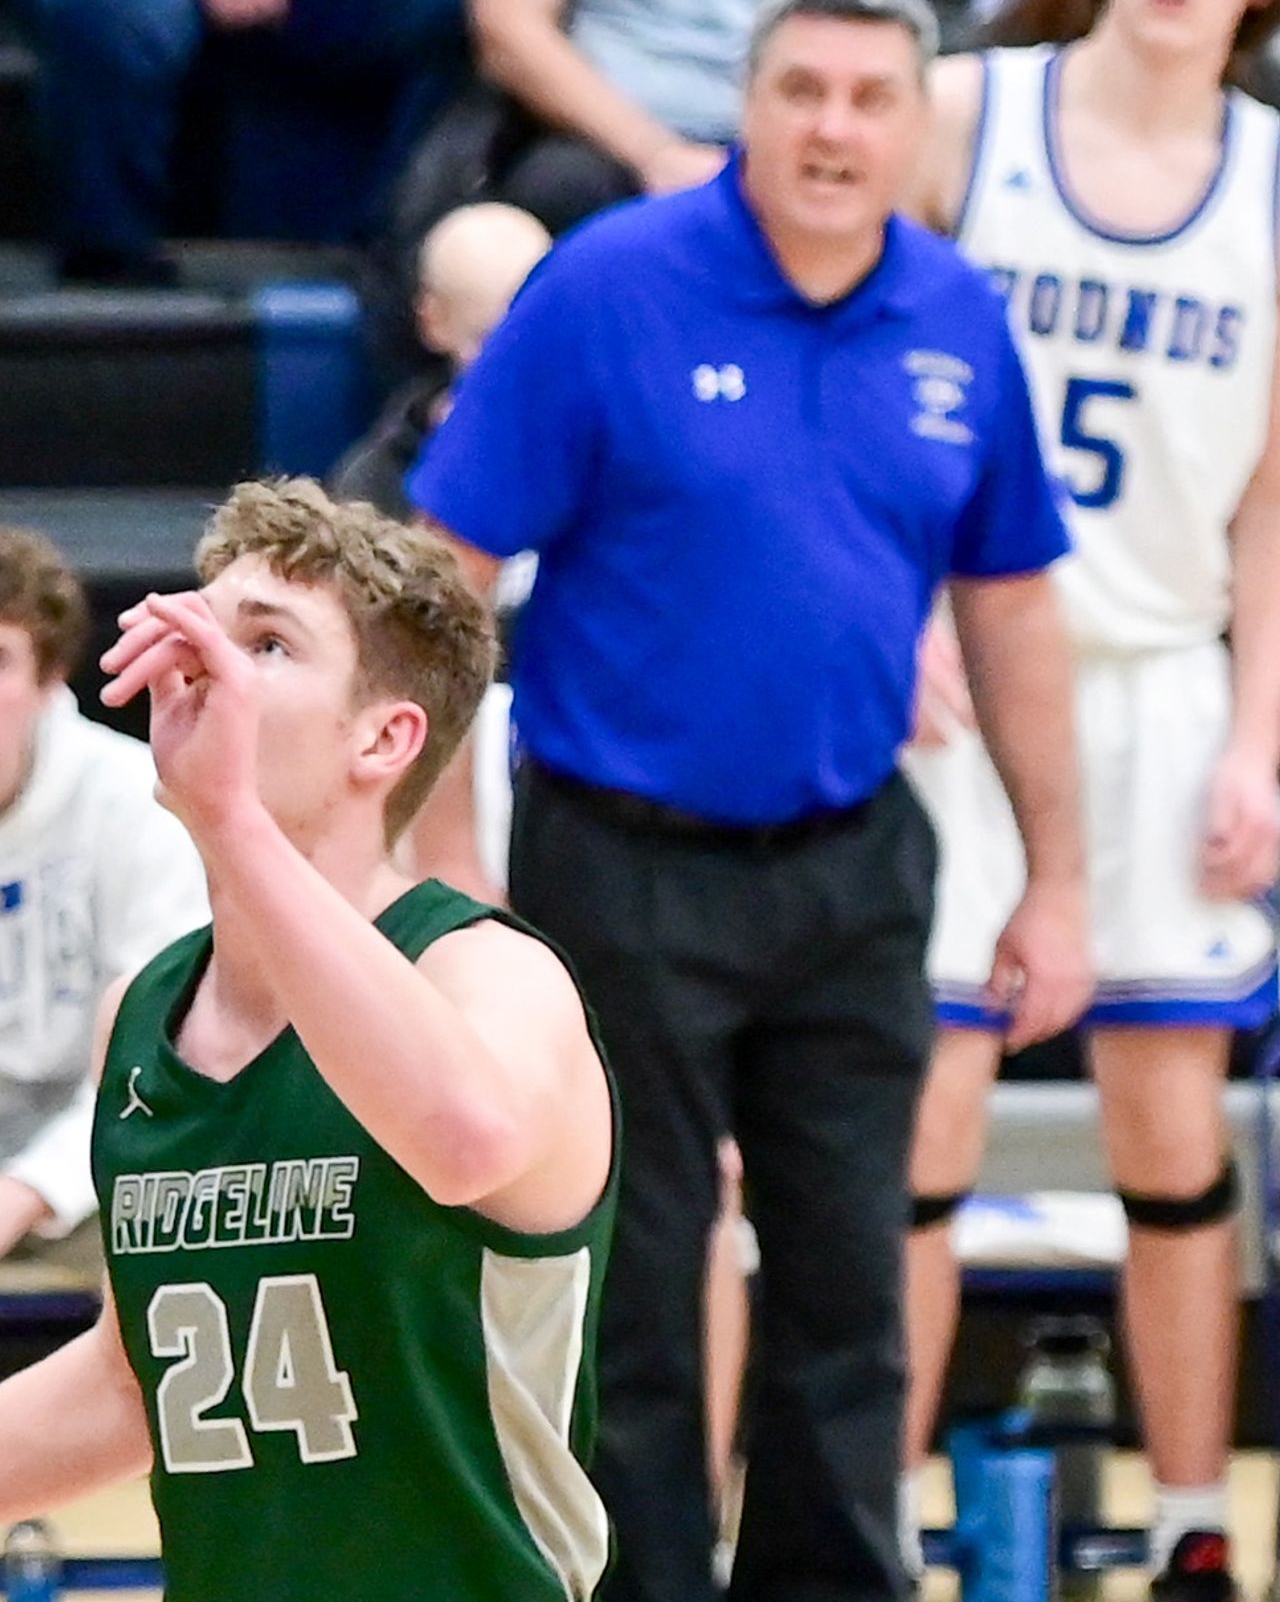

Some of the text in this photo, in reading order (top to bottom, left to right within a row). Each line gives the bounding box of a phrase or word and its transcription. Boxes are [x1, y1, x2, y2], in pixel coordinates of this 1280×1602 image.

[991, 266, 1244, 368] OUNDS
[1059, 375, 1138, 509] 5
[111, 1156, 360, 1255] RIDGELINE
[147, 1274, 359, 1474] 24
